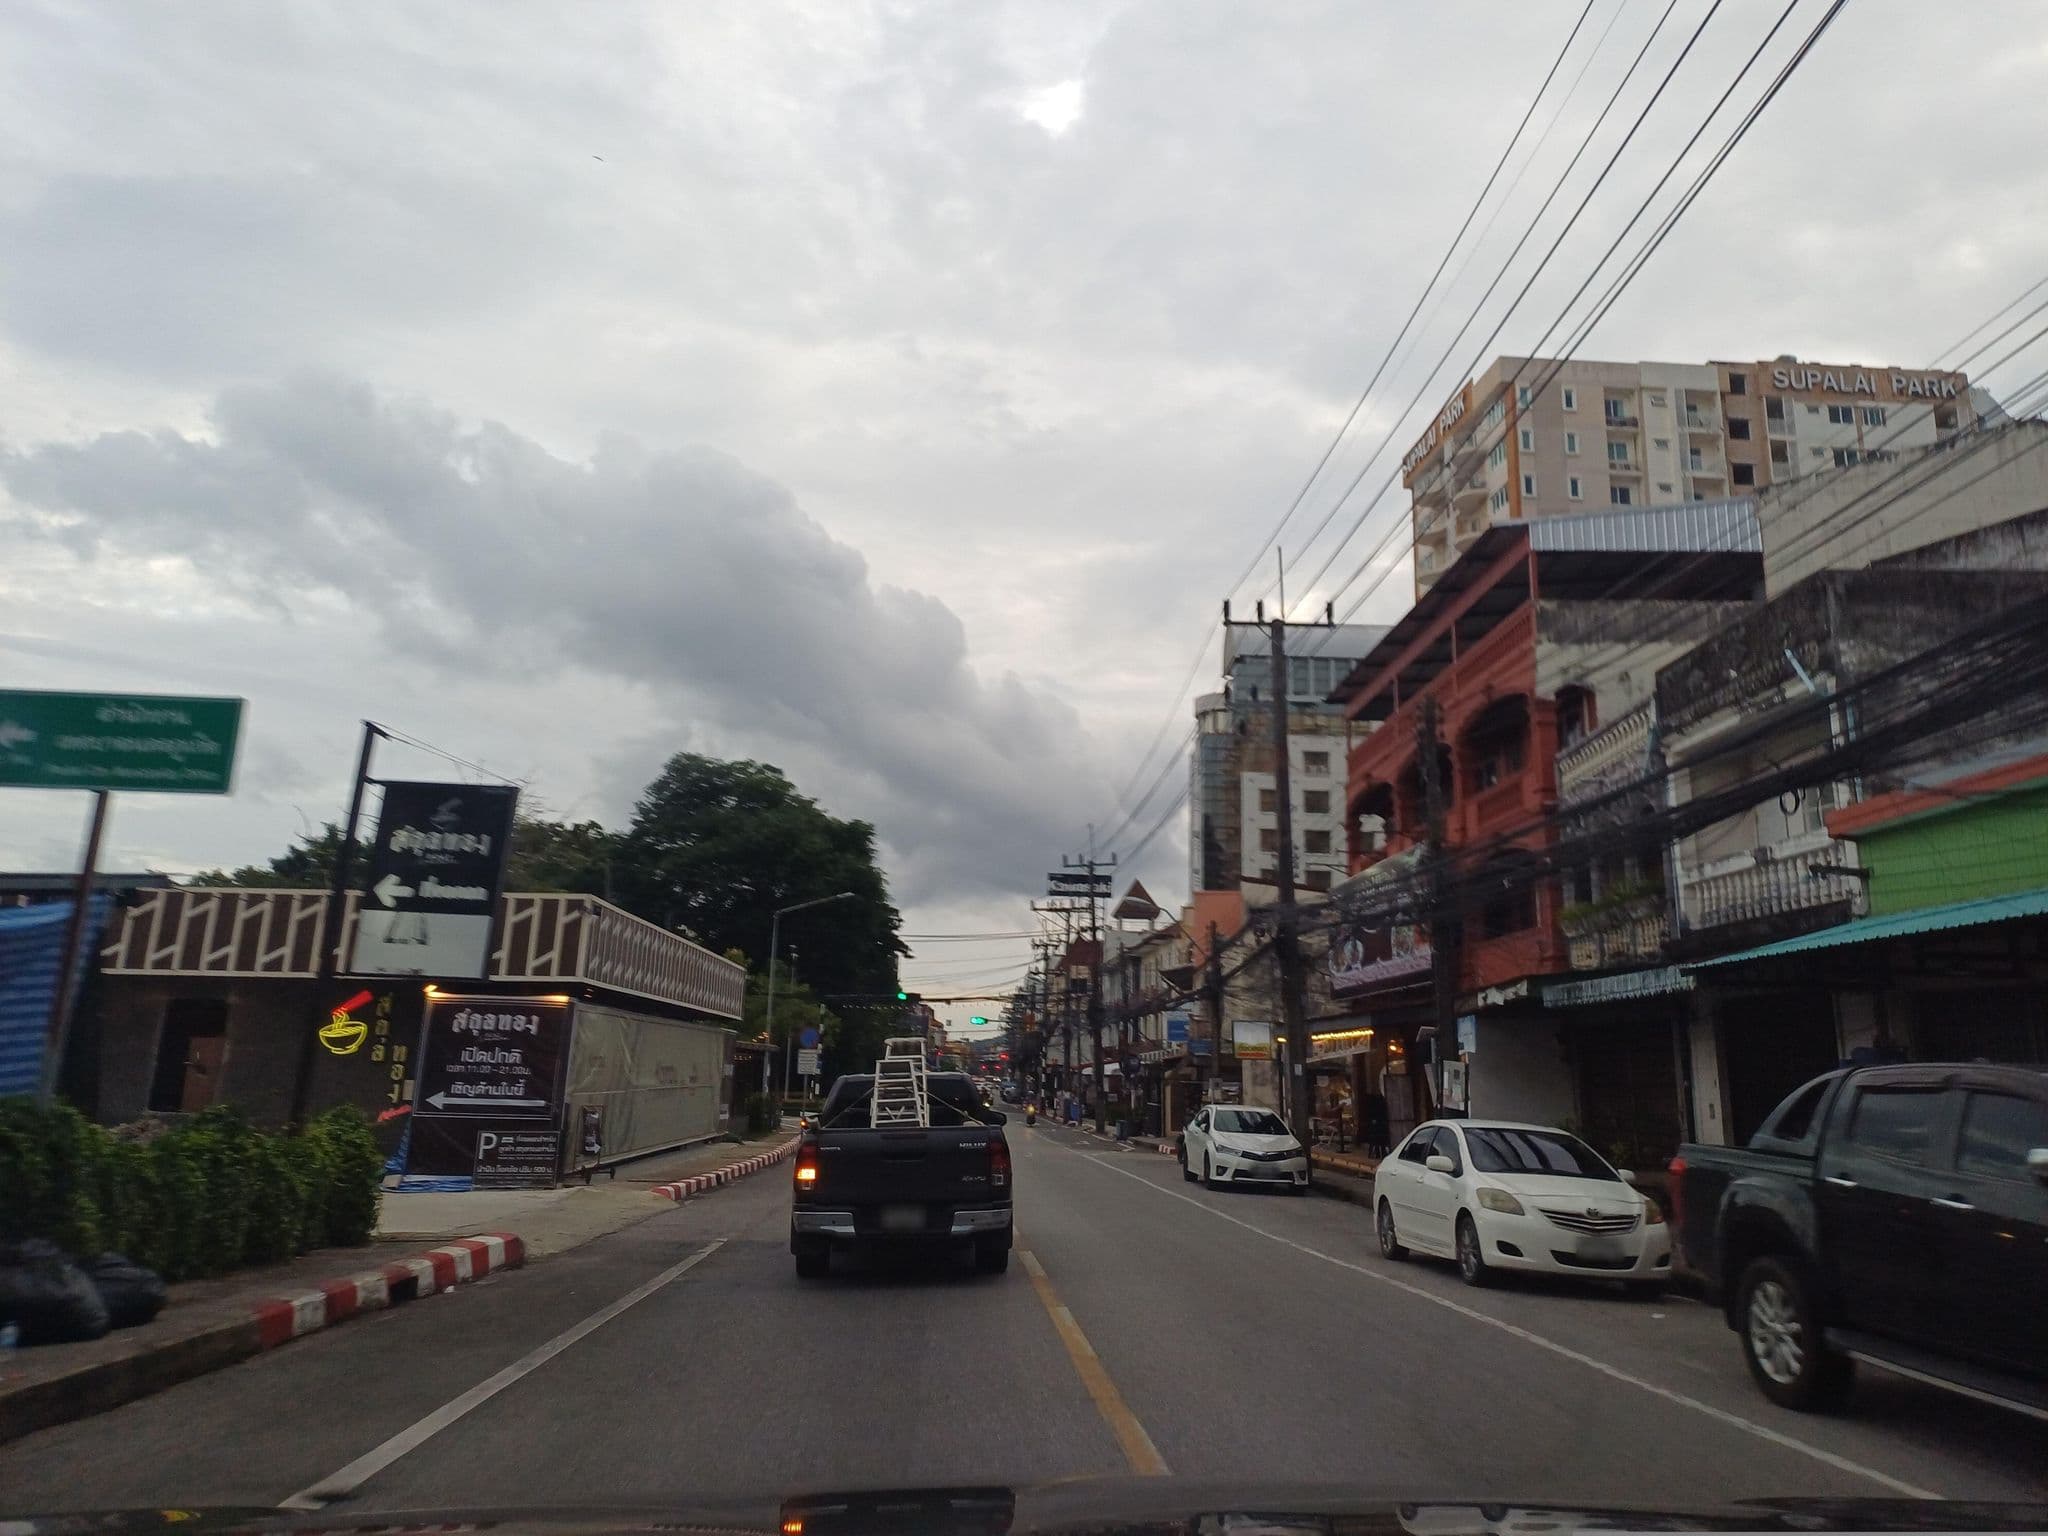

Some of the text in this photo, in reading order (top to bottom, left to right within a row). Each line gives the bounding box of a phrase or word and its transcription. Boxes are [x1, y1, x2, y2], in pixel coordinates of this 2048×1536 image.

[1773, 368, 1957, 398] SUPALAI PARK
[1440, 391, 1465, 437] PARK
[461, 1046, 523, 1064] เปิดปกติ
[479, 1132, 498, 1160] P
